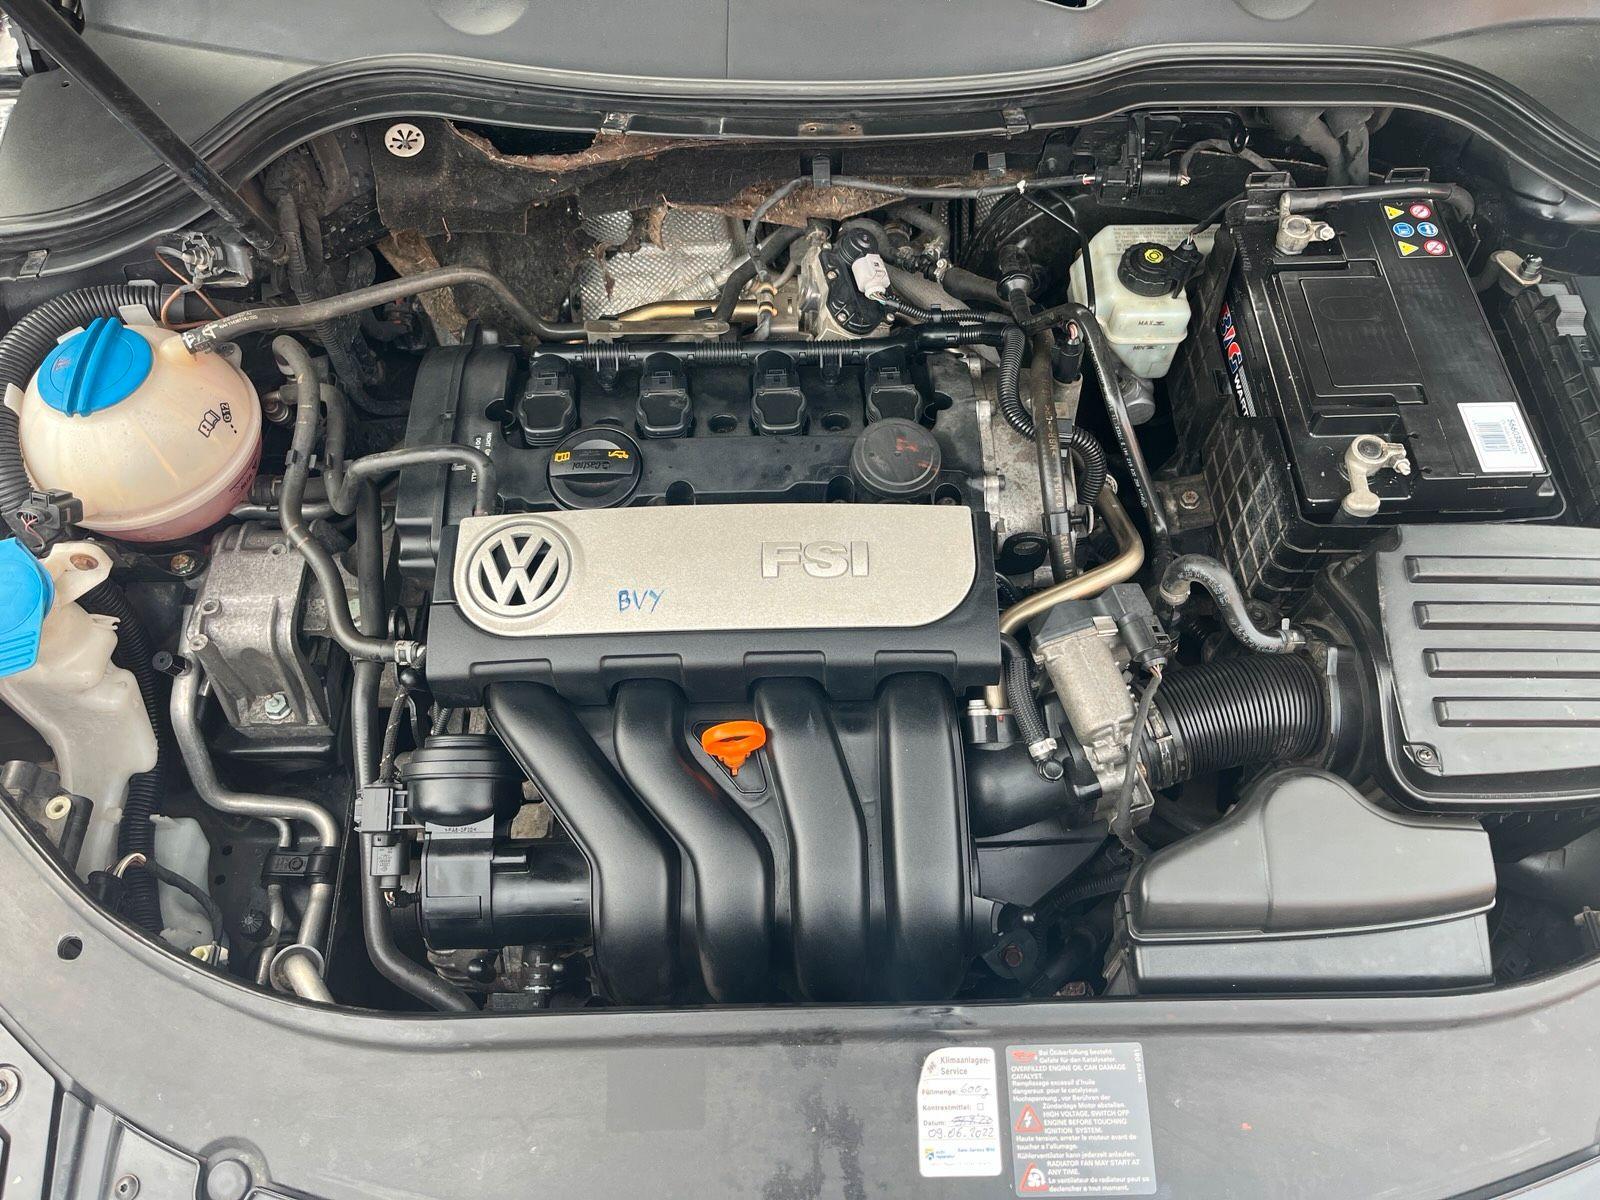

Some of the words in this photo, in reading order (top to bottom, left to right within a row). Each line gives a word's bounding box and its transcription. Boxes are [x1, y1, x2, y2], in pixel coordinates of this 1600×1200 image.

[220, 403, 232, 423] G12
[572, 461, 601, 471] Castrol
[760, 540, 870, 579] FSI
[617, 589, 665, 614] BVY
[940, 1057, 990, 1065] Klimaanlagen-
